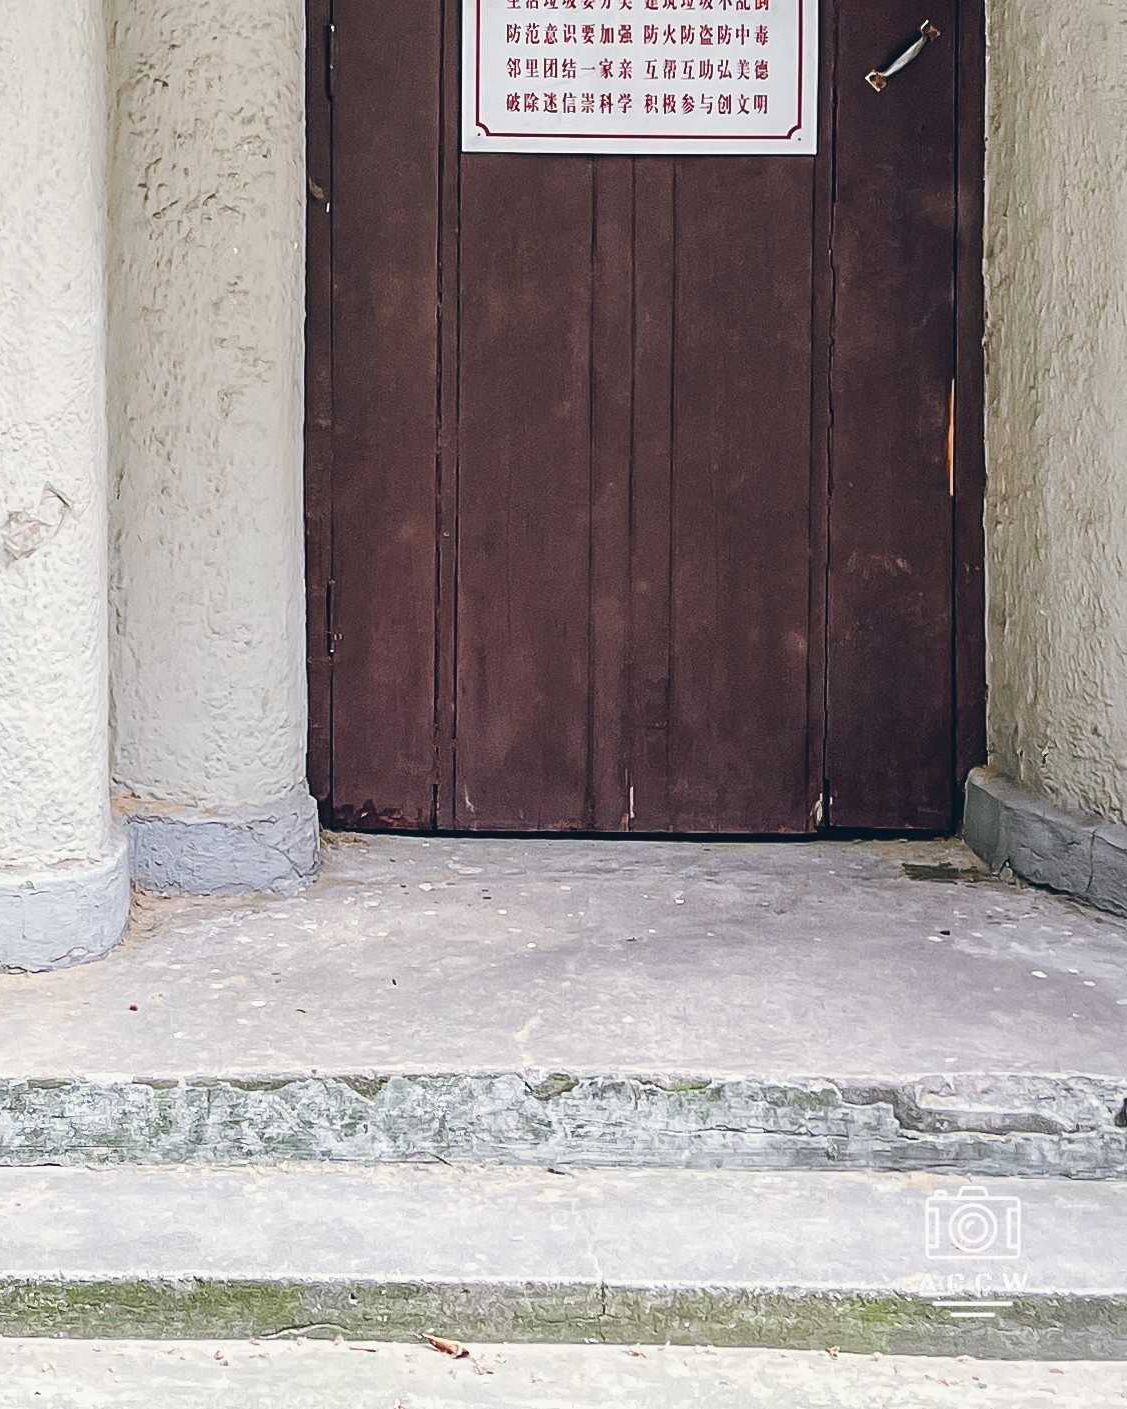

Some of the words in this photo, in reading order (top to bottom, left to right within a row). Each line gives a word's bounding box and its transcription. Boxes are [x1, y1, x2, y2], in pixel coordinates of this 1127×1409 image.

[506, 22, 633, 45] 防范意识要加强
[643, 23, 769, 46] 防火防盗防中毒
[506, 57, 633, 80] 邻里团结一家亲
[643, 58, 769, 81] 互帮互助弘美德
[506, 91, 633, 115] 破除迷信崇科学
[643, 92, 769, 115] 积极参与创文明
